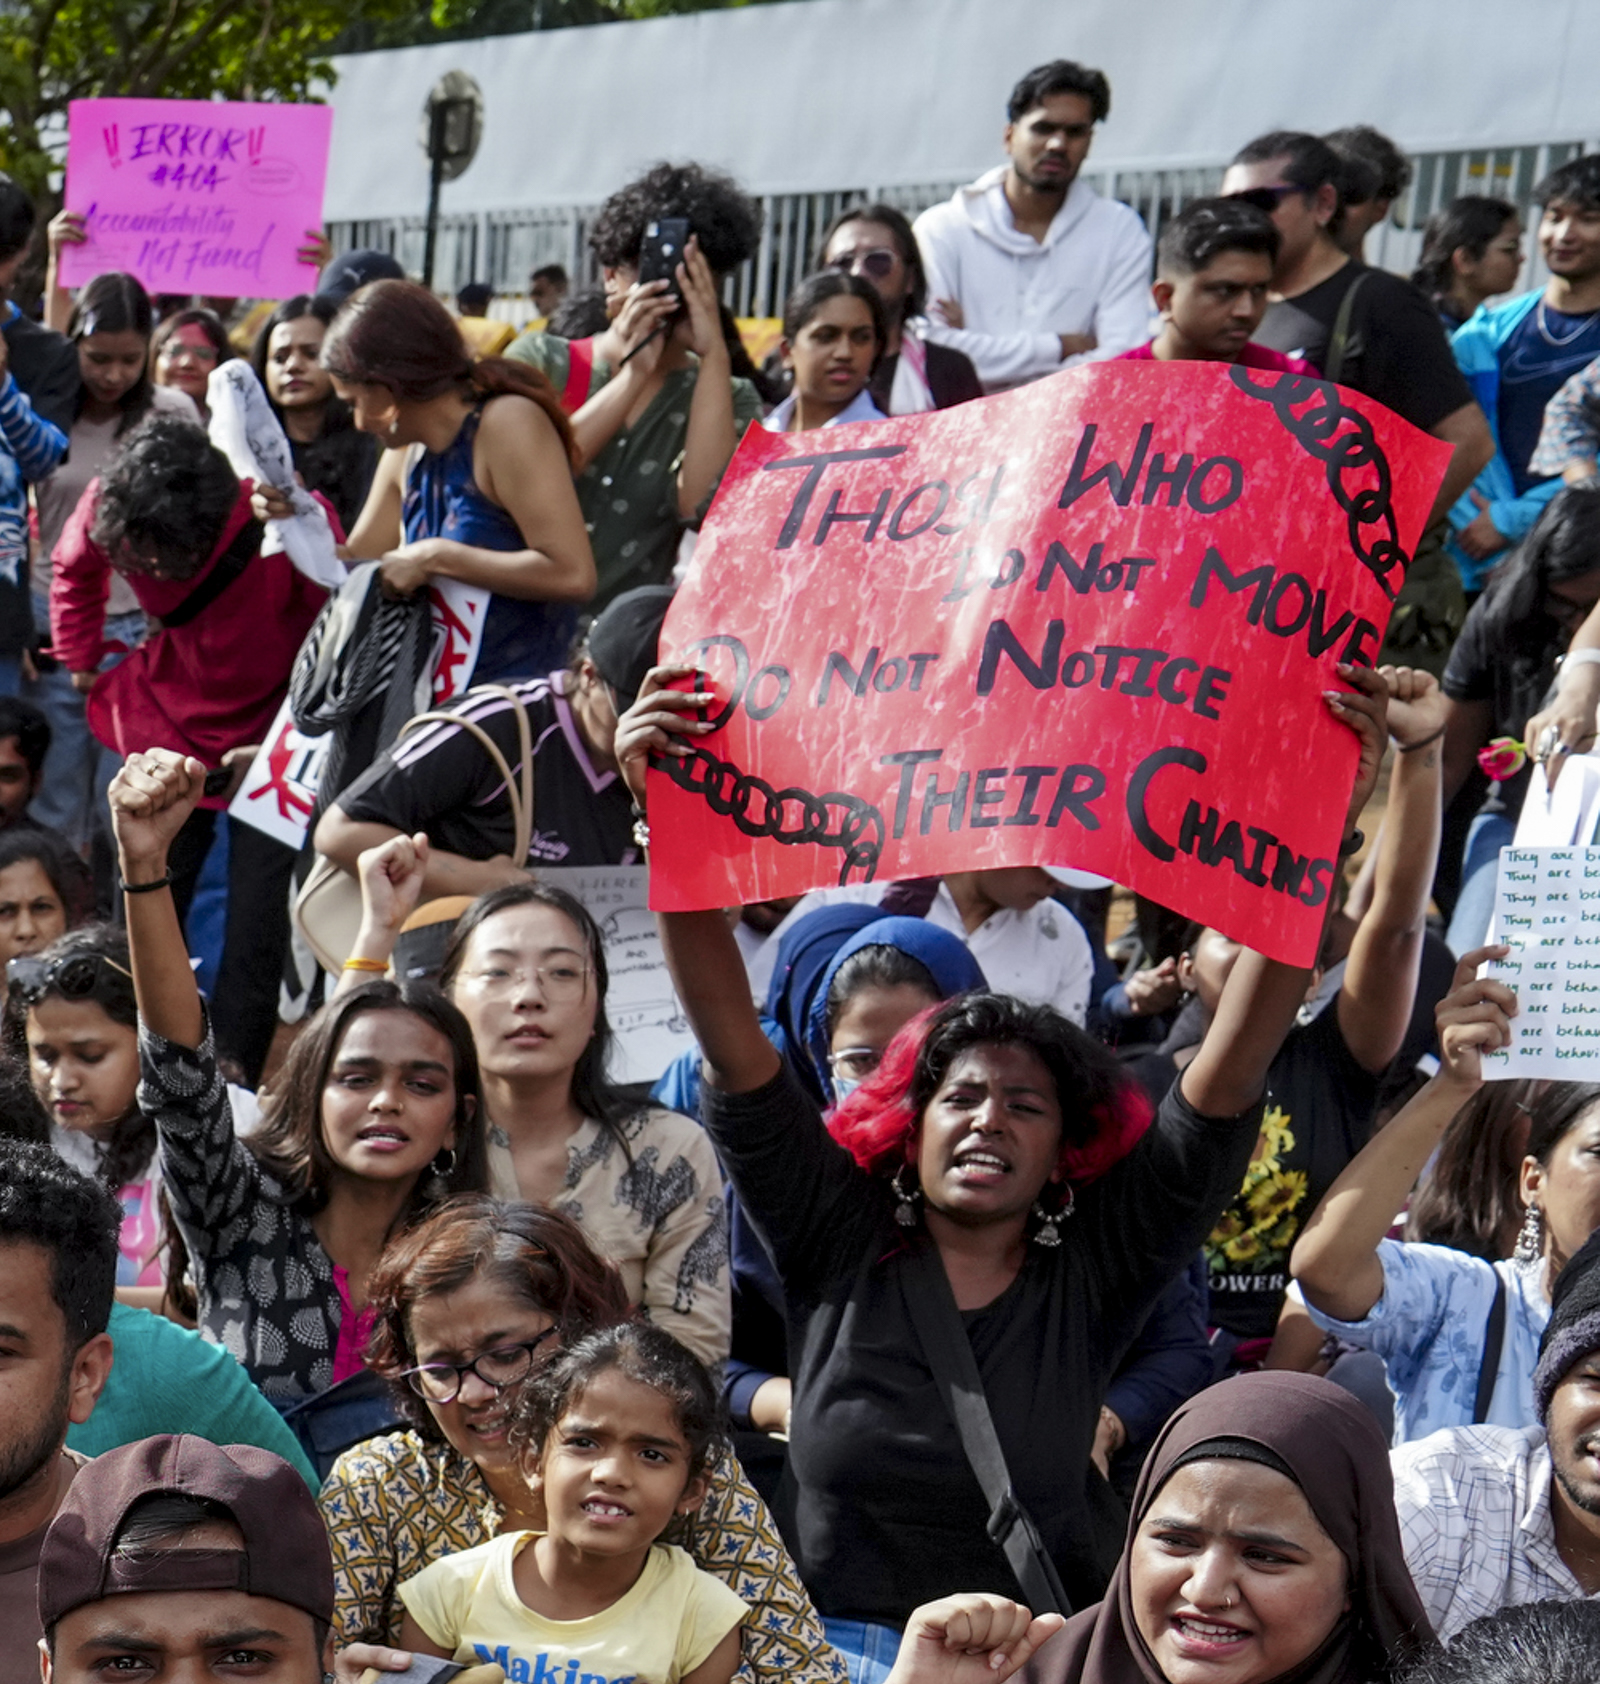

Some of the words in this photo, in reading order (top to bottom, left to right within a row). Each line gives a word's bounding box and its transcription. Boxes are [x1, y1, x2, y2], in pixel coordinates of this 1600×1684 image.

[128, 122, 246, 163] ERROR
[148, 163, 231, 194] #404
[1058, 423, 1243, 514] WHO
[942, 546, 1026, 603] DO
[1035, 541, 1157, 594] NOT
[1189, 547, 1381, 669] MOVE
[684, 634, 791, 734] DO
[817, 646, 940, 708] NOT
[975, 618, 1232, 720] NOTICE
[880, 748, 1108, 841] THEIR
[1126, 745, 1335, 908] CHAINS
[1505, 850, 1539, 869] They
[1550, 852, 1574, 861] are
[1548, 868, 1571, 878] are
[579, 876, 642, 891] HERE
[1546, 892, 1569, 901] are
[1542, 915, 1567, 925] are
[1540, 937, 1566, 946] are
[1534, 961, 1557, 970] are
[1529, 982, 1553, 992] are
[1528, 1003, 1549, 1013] are
[1521, 1028, 1543, 1037] are
[1520, 1047, 1543, 1056] are
